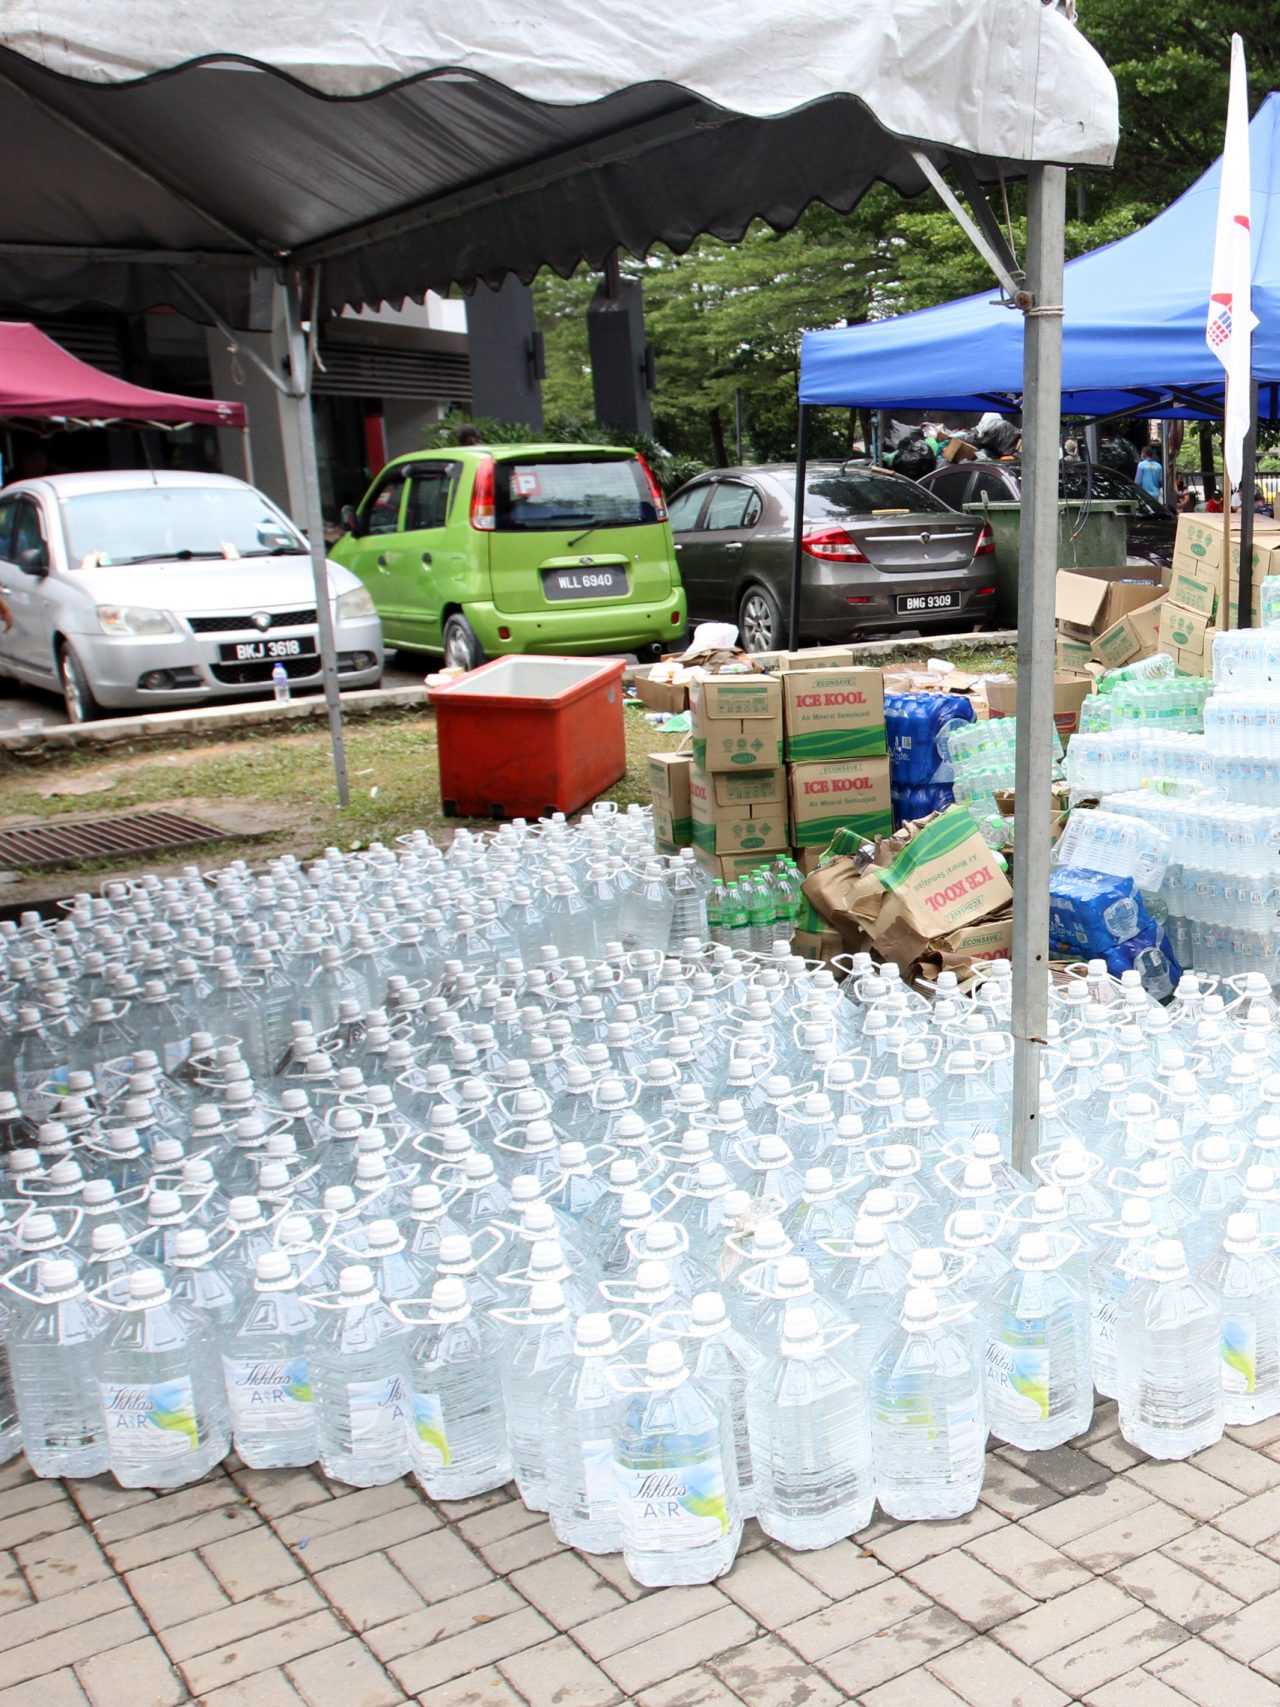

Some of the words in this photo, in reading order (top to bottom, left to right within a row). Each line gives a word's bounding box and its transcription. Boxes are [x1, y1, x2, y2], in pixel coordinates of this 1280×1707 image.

[518, 475, 537, 494] P
[558, 576, 581, 589] WLL
[582, 574, 612, 587] 6940
[906, 597, 926, 610] BMG
[927, 595, 951, 607] 9309
[236, 643, 265, 659] BKJ
[267, 640, 300, 657] 3618
[795, 694, 822, 708] ICE
[823, 691, 867, 707] KOOL
[803, 780, 829, 795] ICE
[832, 777, 873, 792] KOOL
[965, 866, 994, 890] ICE
[924, 880, 968, 912] KOOL
[962, 934, 998, 947] ECONSAVE
[235, 1361, 292, 1387] Ikhlas
[104, 1386, 155, 1411] Ikhlas
[631, 1472, 689, 1499] Ikhlas
